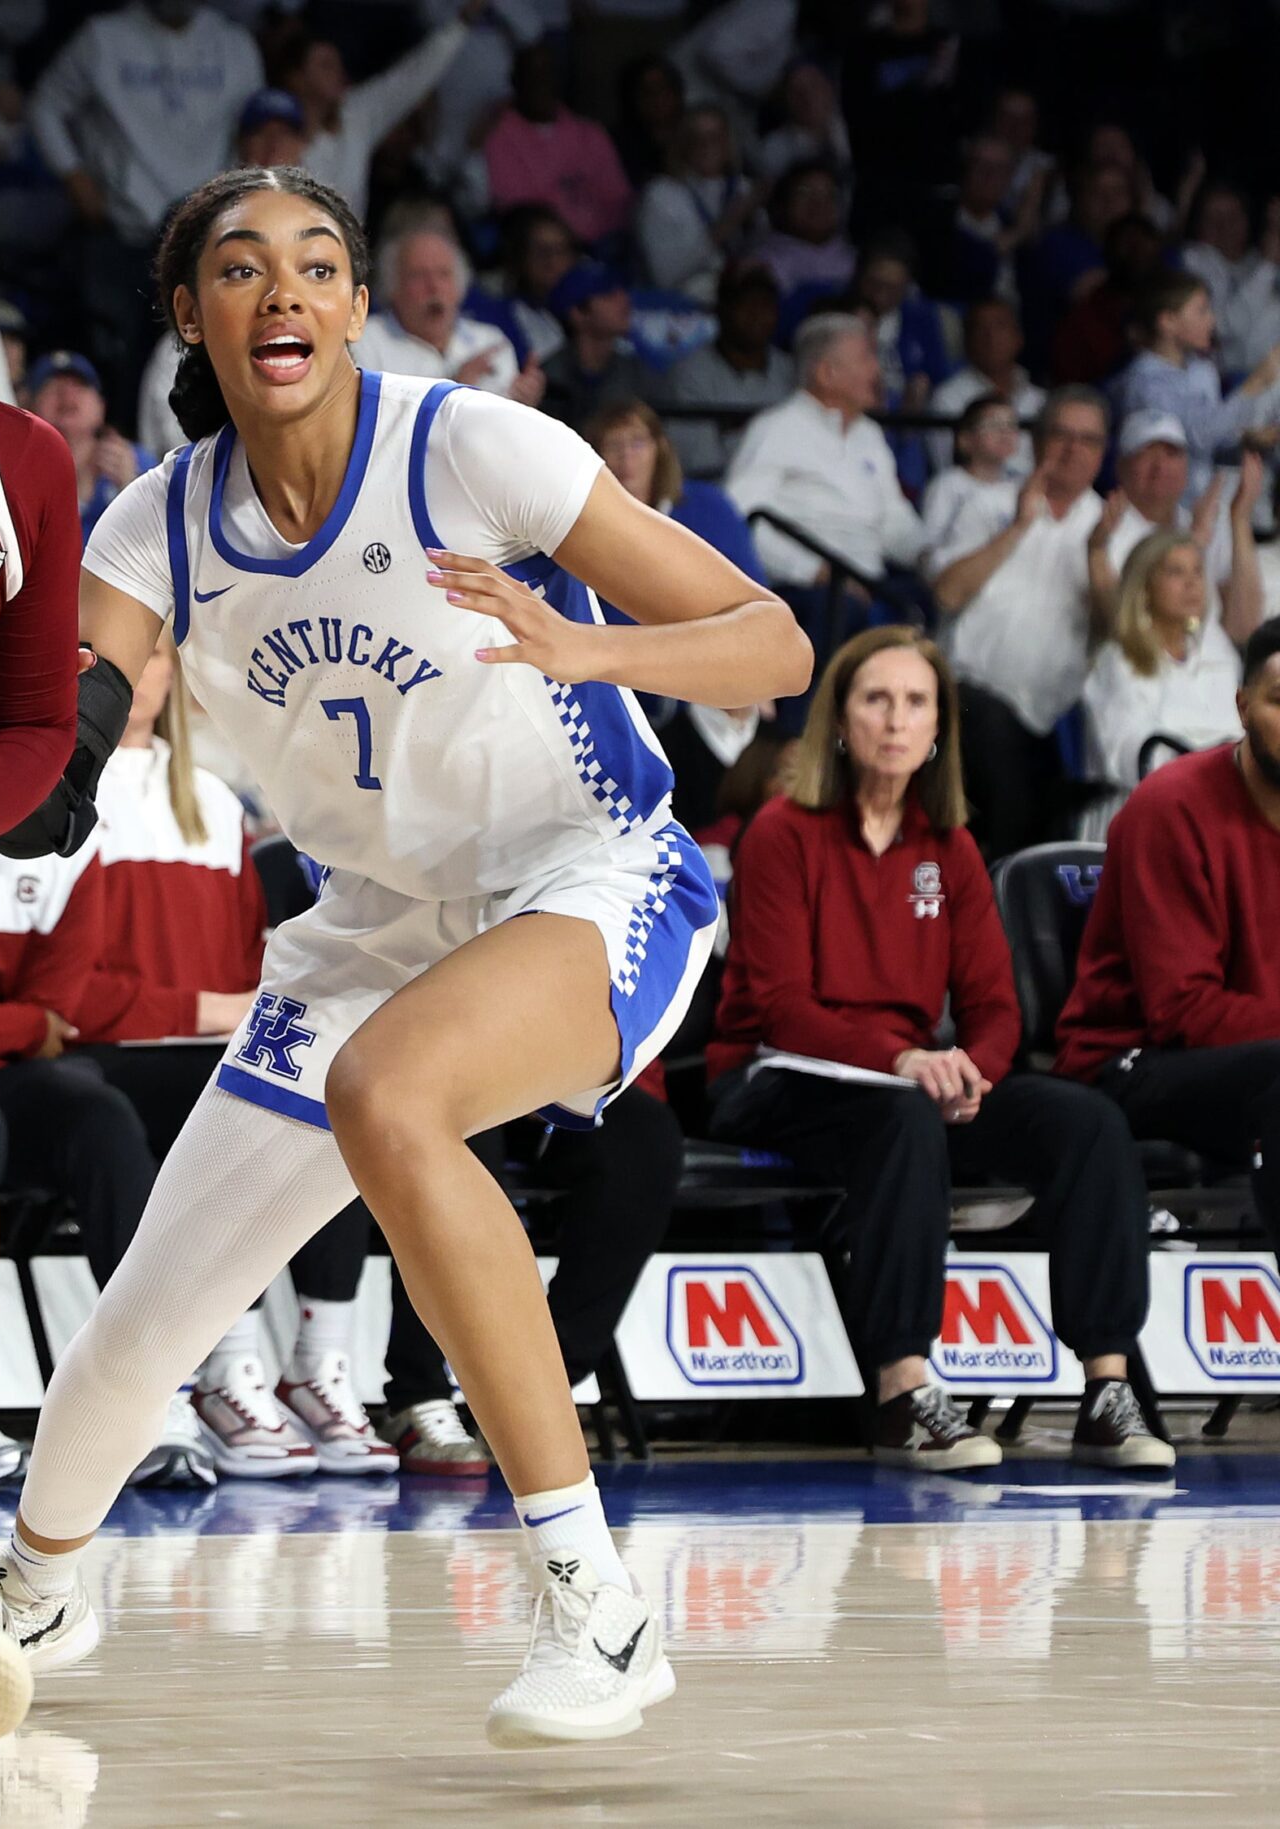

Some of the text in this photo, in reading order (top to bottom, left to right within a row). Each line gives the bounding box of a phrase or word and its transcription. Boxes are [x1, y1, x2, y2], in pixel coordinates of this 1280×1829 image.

[364, 543, 391, 573] SEC
[247, 616, 443, 708] KENTUCKY
[320, 696, 383, 790] 7
[685, 1281, 781, 1348] M
[940, 1280, 1035, 1345] M
[692, 1352, 792, 1370] Marathon
[943, 1349, 1046, 1367] Marathon
[1209, 1347, 1280, 1366] Marath
